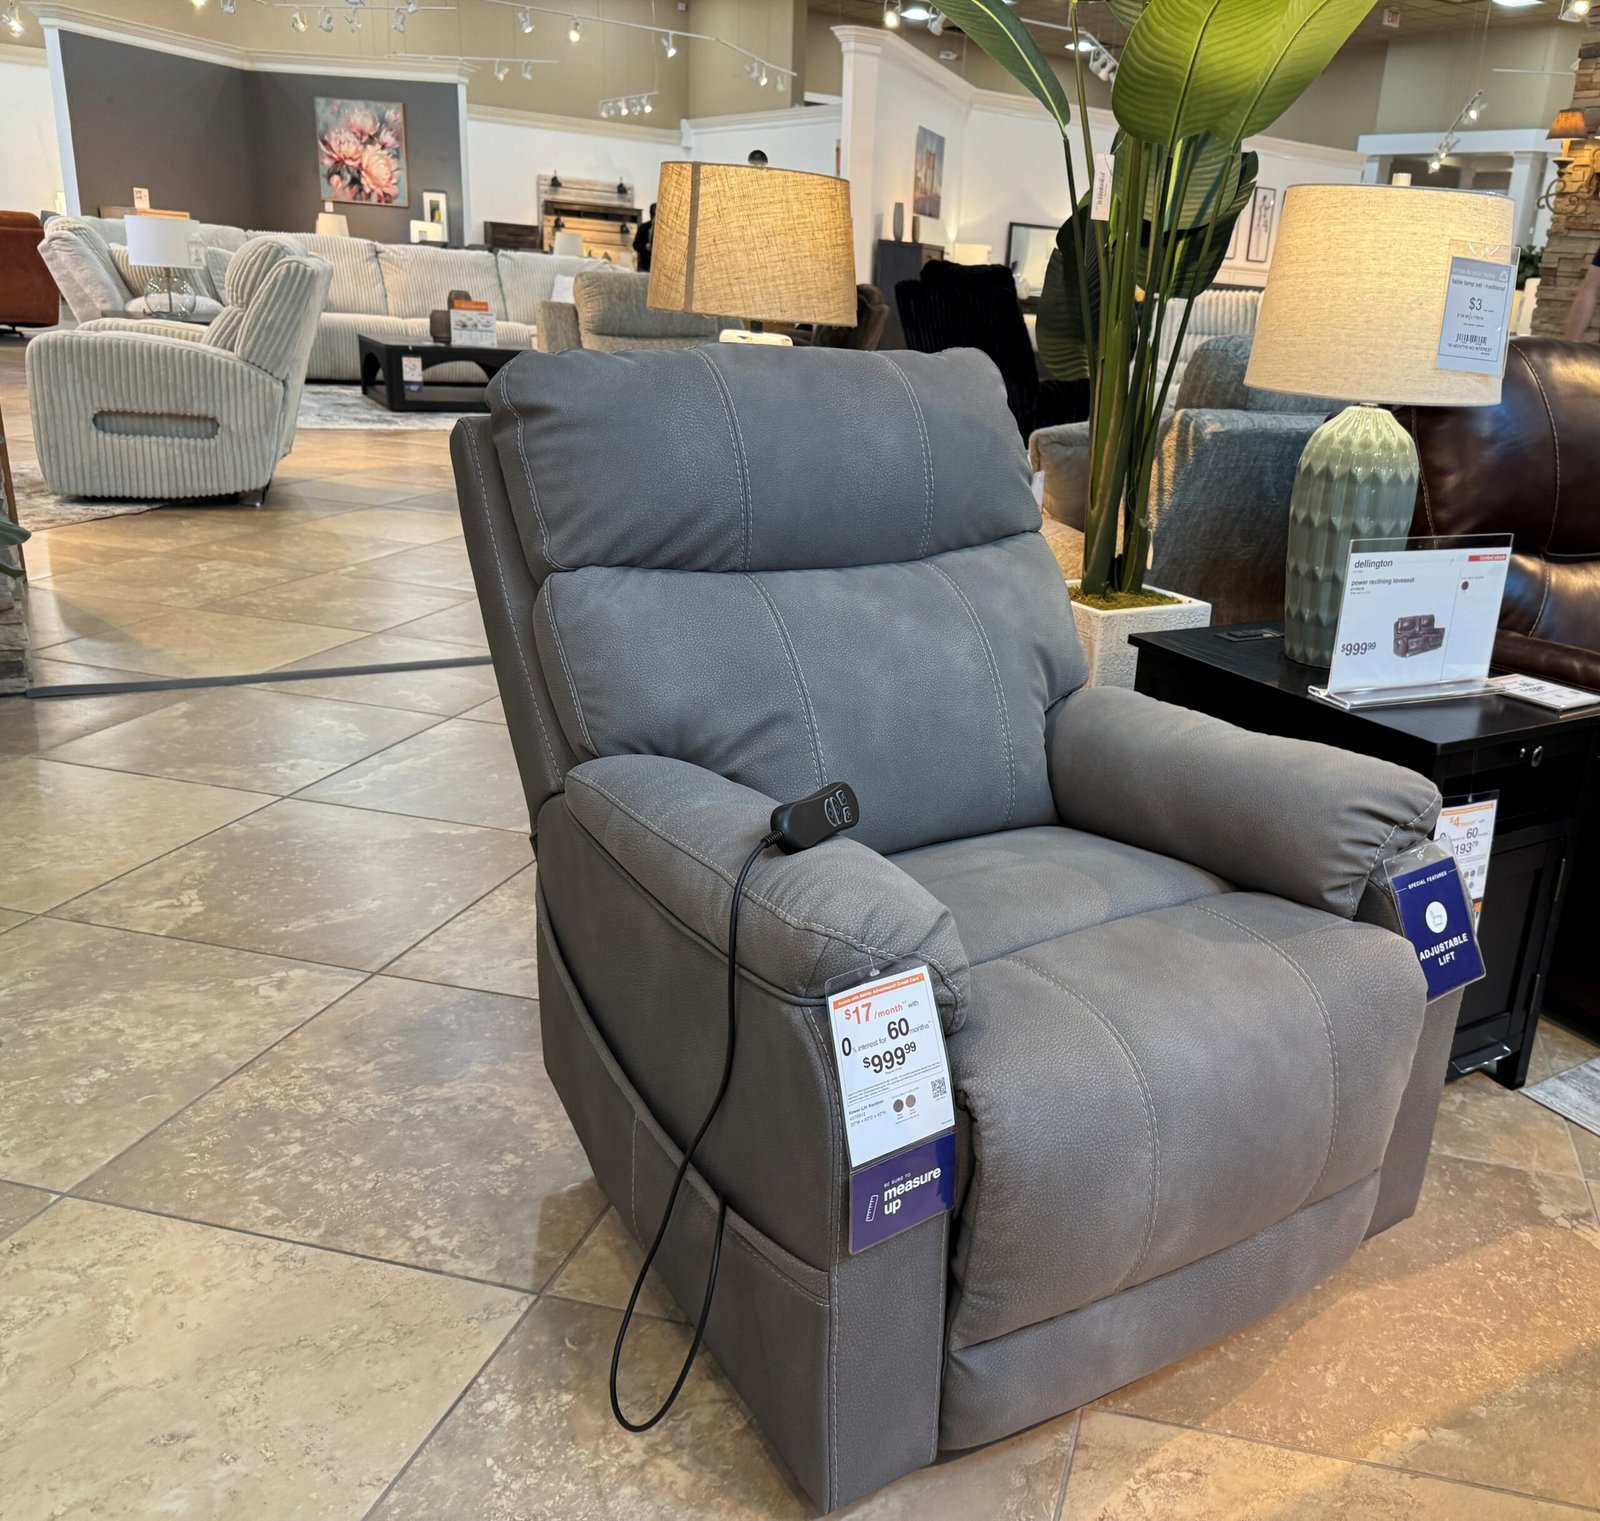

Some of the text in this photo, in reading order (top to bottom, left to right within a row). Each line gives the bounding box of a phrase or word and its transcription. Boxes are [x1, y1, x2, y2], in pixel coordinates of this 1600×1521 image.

[1468, 297, 1482, 311] $3
[1354, 560, 1393, 569] dellington
[1466, 827, 1478, 839] 60
[1408, 870, 1447, 890] SPECIAL FEATURES
[1420, 932, 1468, 961] ADJUSTABLE
[1438, 952, 1455, 966] LIFT
[844, 1002, 872, 1024] $17
[908, 1000, 919, 1008] with
[858, 1040, 878, 1052] interest
[887, 1018, 909, 1040] 60
[849, 1107, 861, 1115] Power
[861, 1103, 869, 1111] Lift
[884, 1168, 941, 1201] measure
[891, 1176, 904, 1184] SURE
[884, 1199, 902, 1215] up
